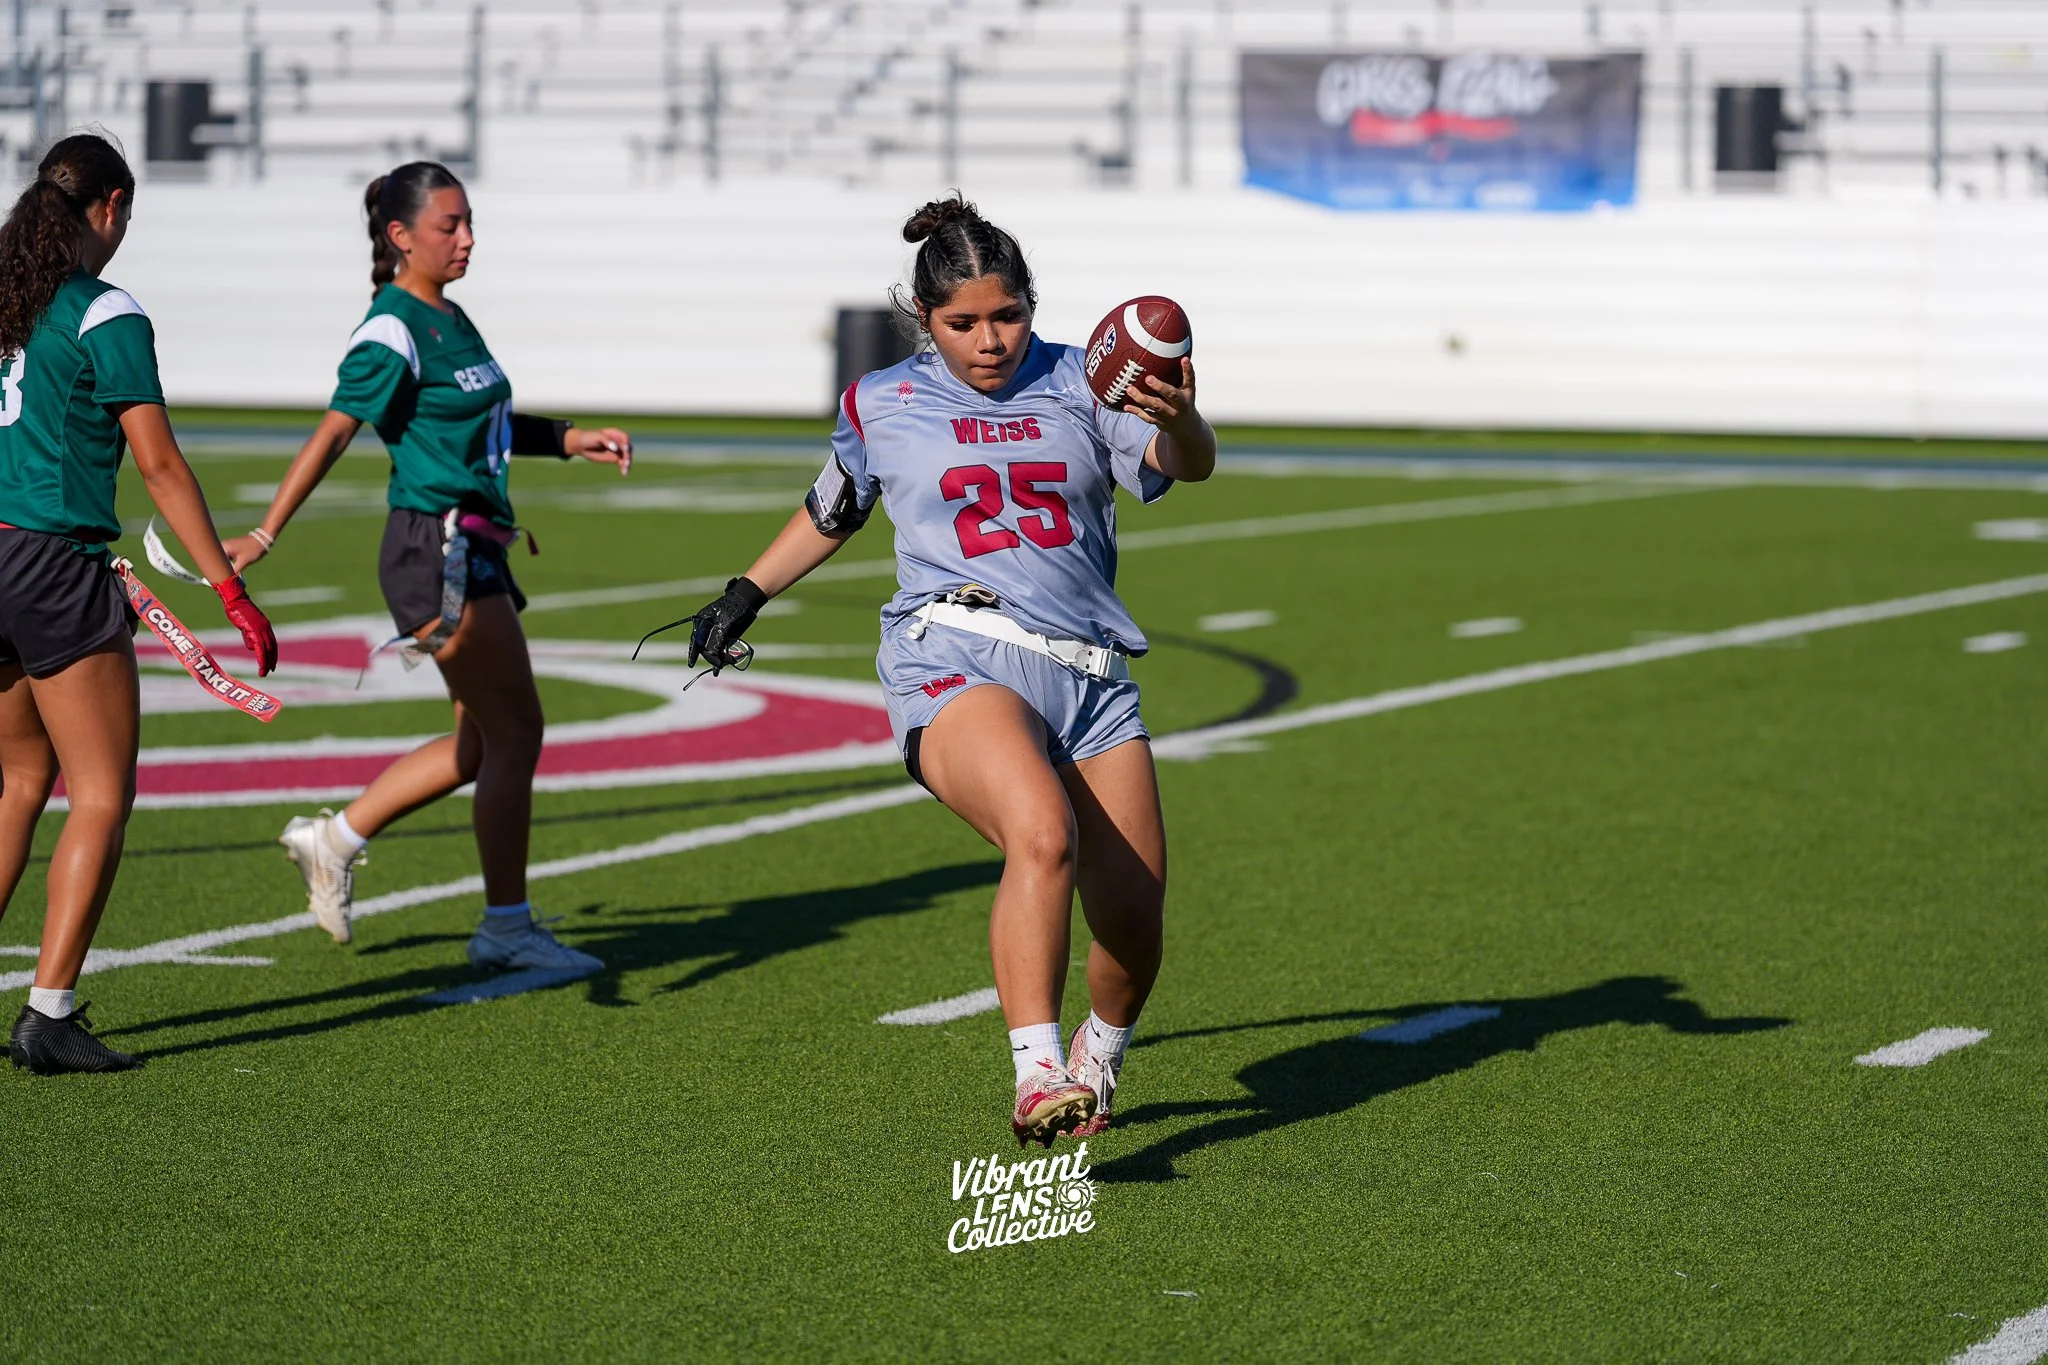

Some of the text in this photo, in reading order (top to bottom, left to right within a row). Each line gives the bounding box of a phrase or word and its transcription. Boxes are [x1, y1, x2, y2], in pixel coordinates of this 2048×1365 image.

[1087, 345, 1107, 377] USA
[949, 417, 1042, 444] WEISS
[939, 462, 1076, 559] 25
[147, 607, 251, 702] COME AND TAKE IT
[245, 693, 263, 710] TEXAS
[253, 696, 270, 712] FURY
